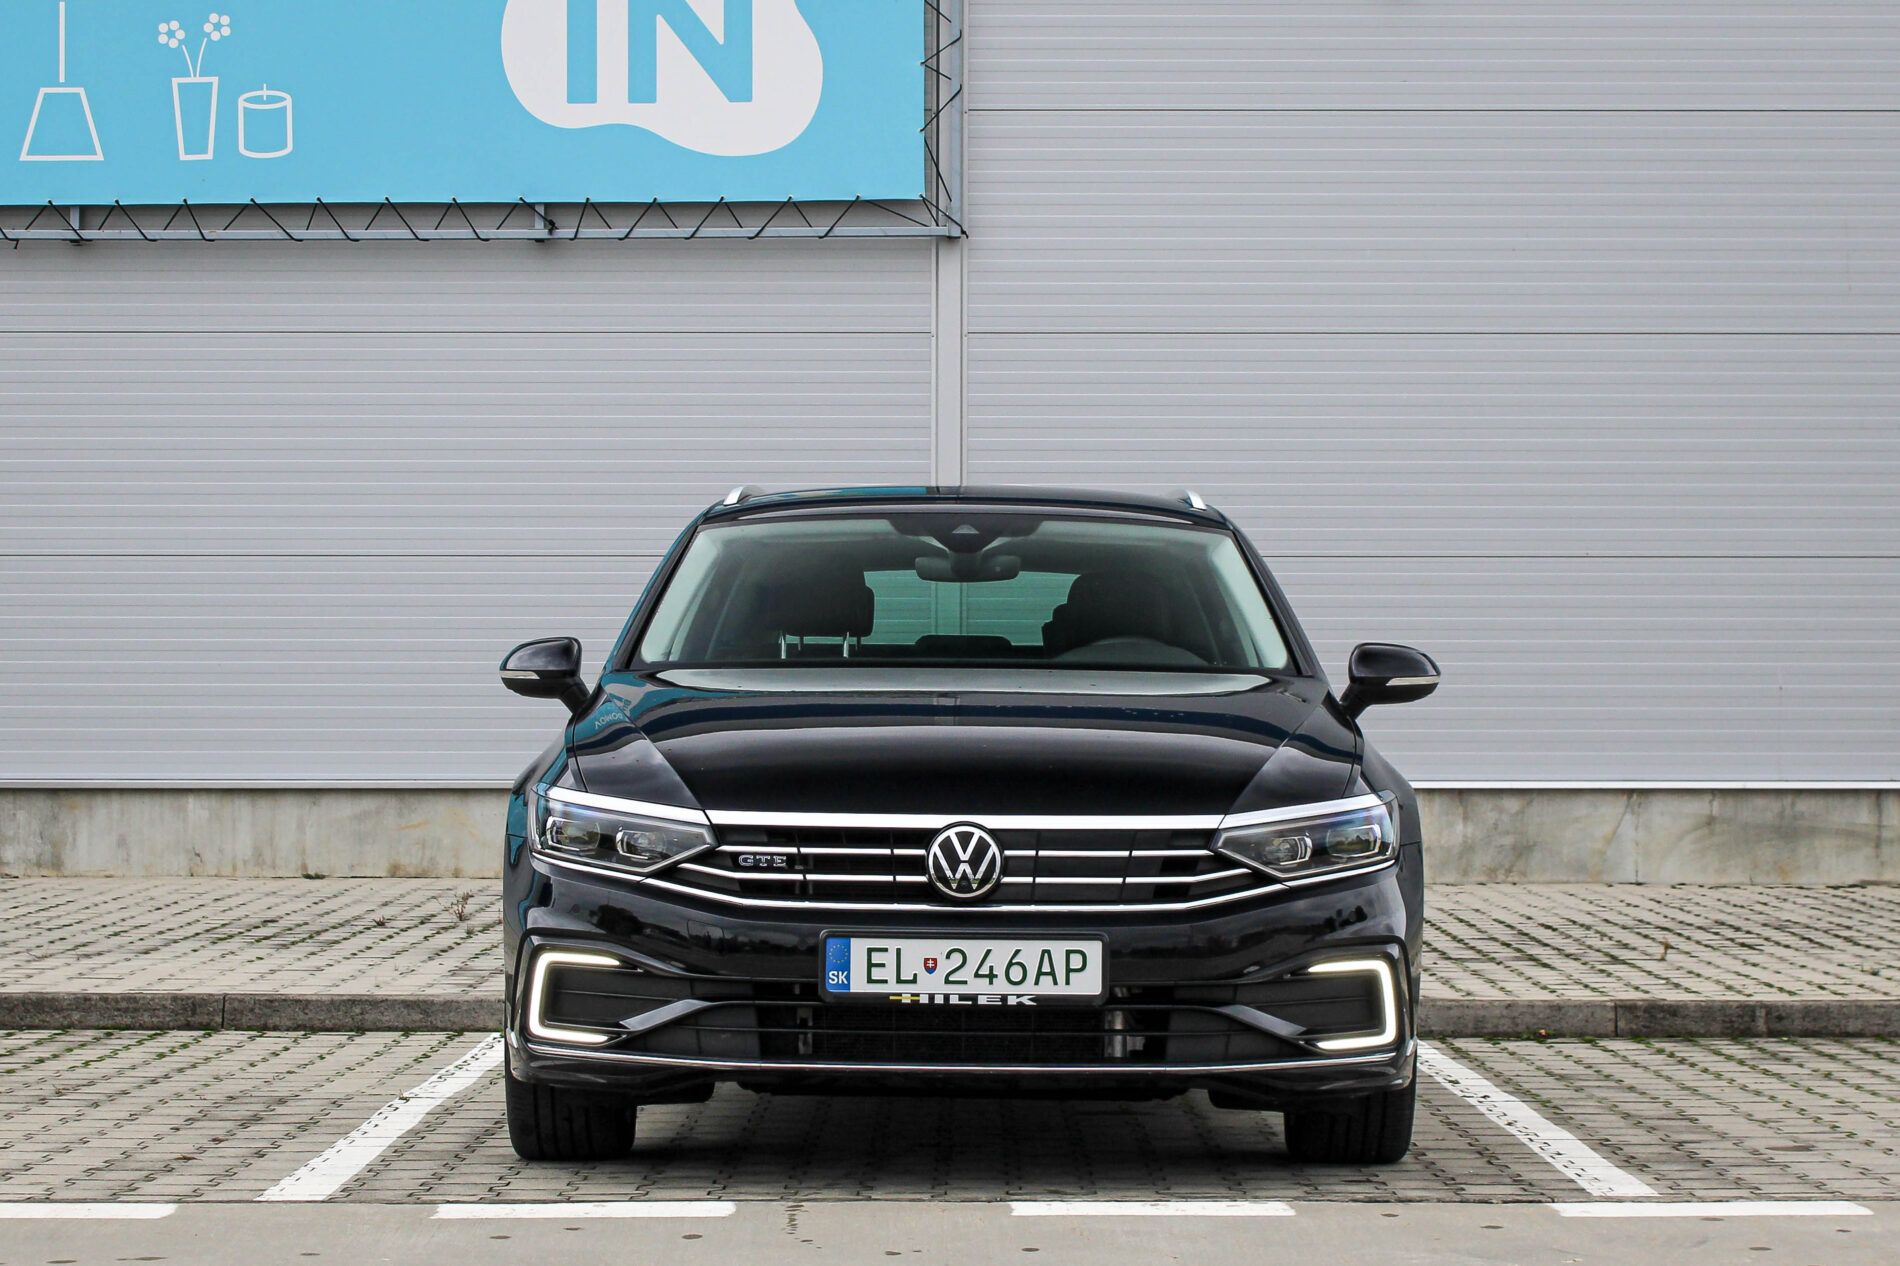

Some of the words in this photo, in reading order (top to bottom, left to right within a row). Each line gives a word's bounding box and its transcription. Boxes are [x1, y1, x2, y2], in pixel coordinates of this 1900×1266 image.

[567, 0, 753, 104] IN
[738, 854, 787, 867] GTE
[828, 971, 848, 985] SK
